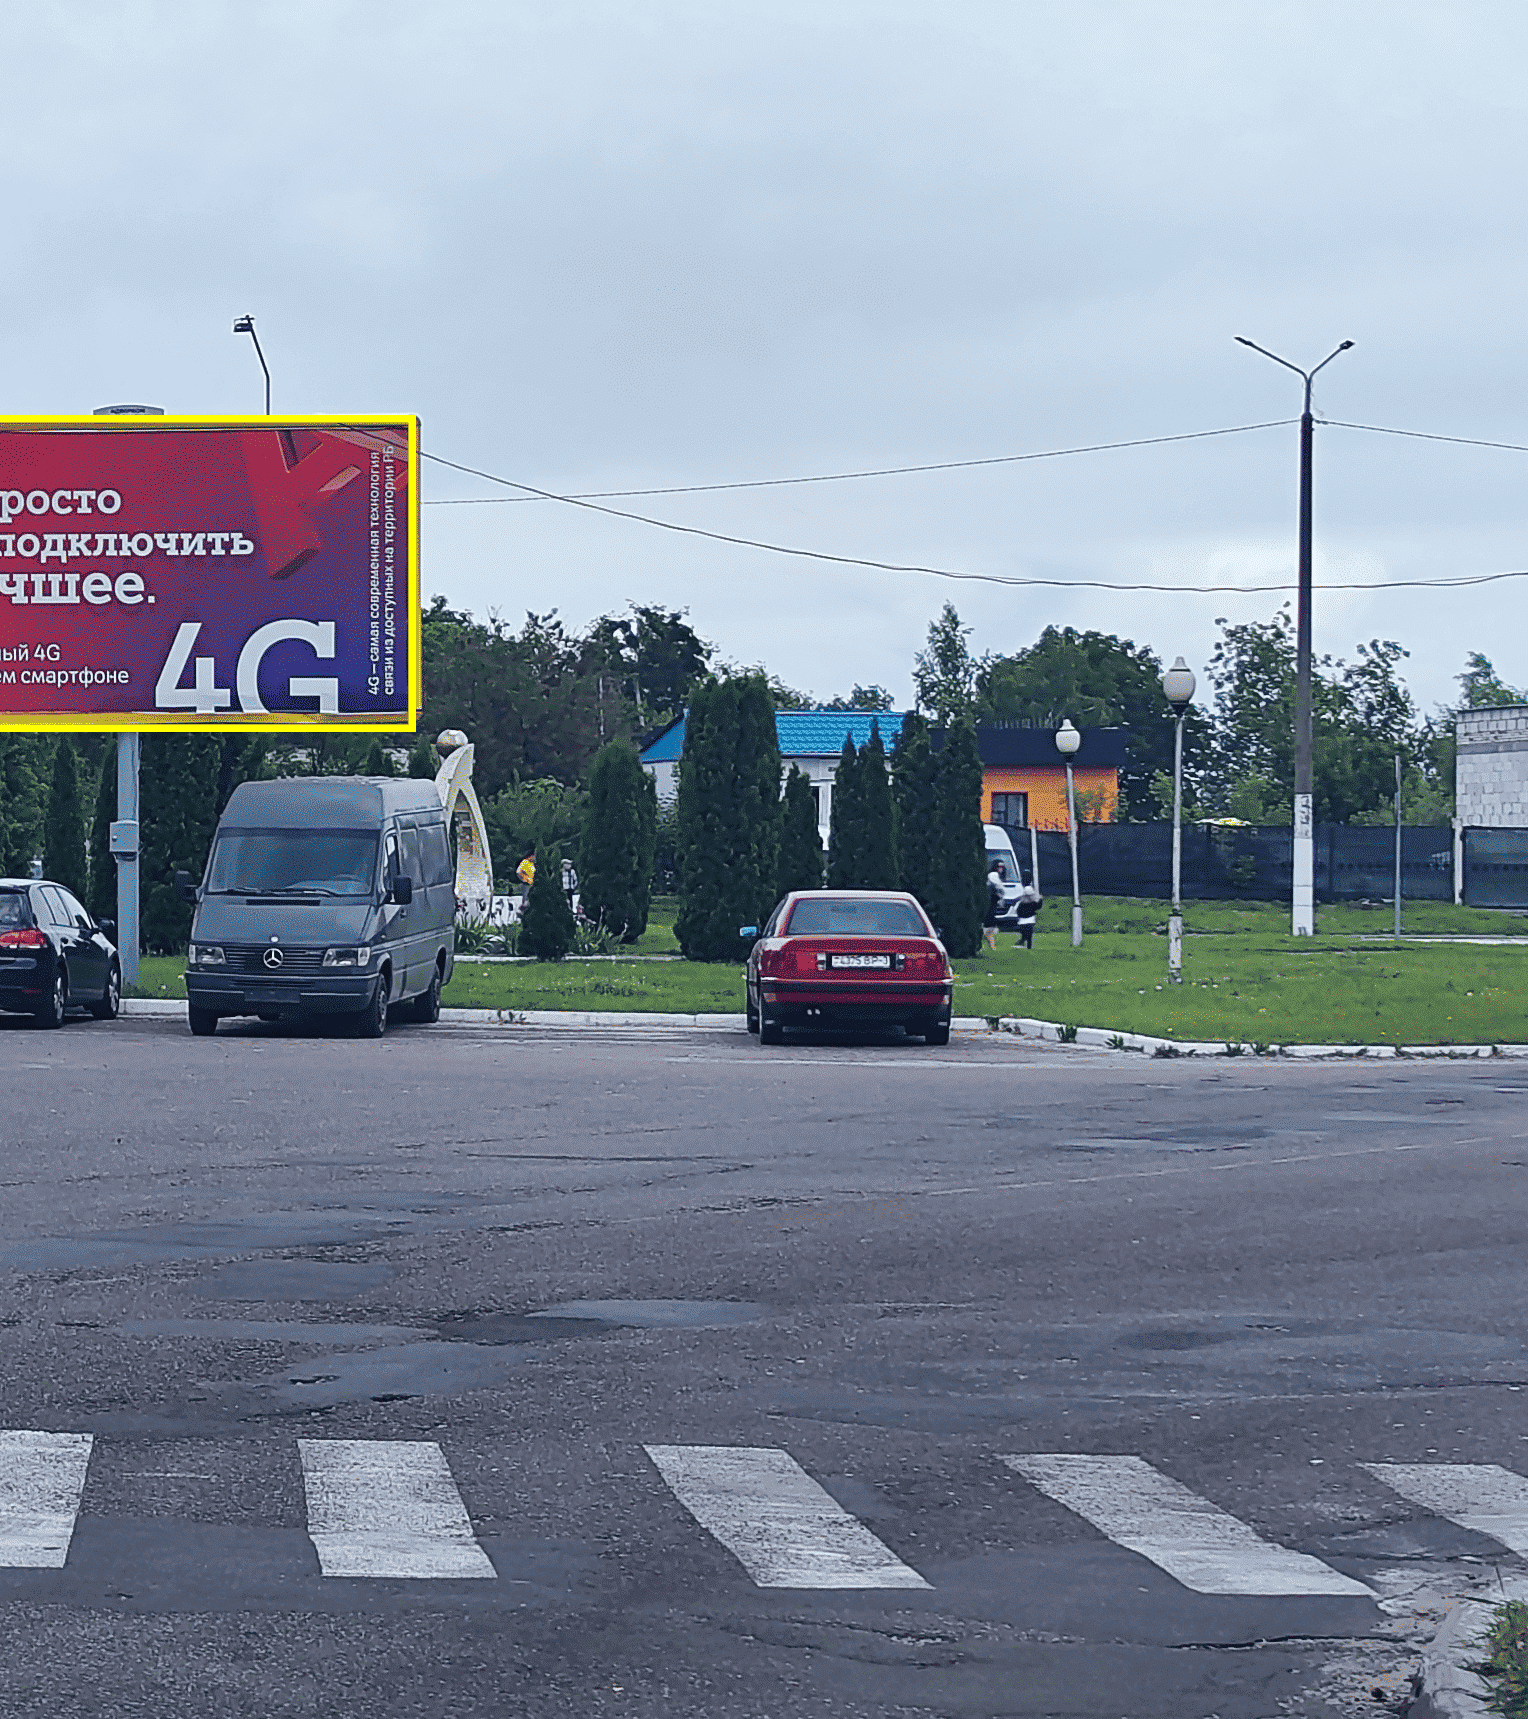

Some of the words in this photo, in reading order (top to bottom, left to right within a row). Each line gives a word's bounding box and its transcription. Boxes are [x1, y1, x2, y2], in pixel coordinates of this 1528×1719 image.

[370, 451, 381, 529] технология
[384, 465, 397, 545] территории
[370, 530, 382, 619] современная
[384, 546, 394, 563] на
[384, 565, 397, 637] доступных
[33, 643, 62, 662] 4G
[370, 620, 380, 662] самая
[384, 638, 394, 655] из
[20, 666, 130, 689] смартфоне
[155, 618, 339, 713] 4G
[384, 657, 395, 695] связи
[368, 676, 380, 696] 4G
